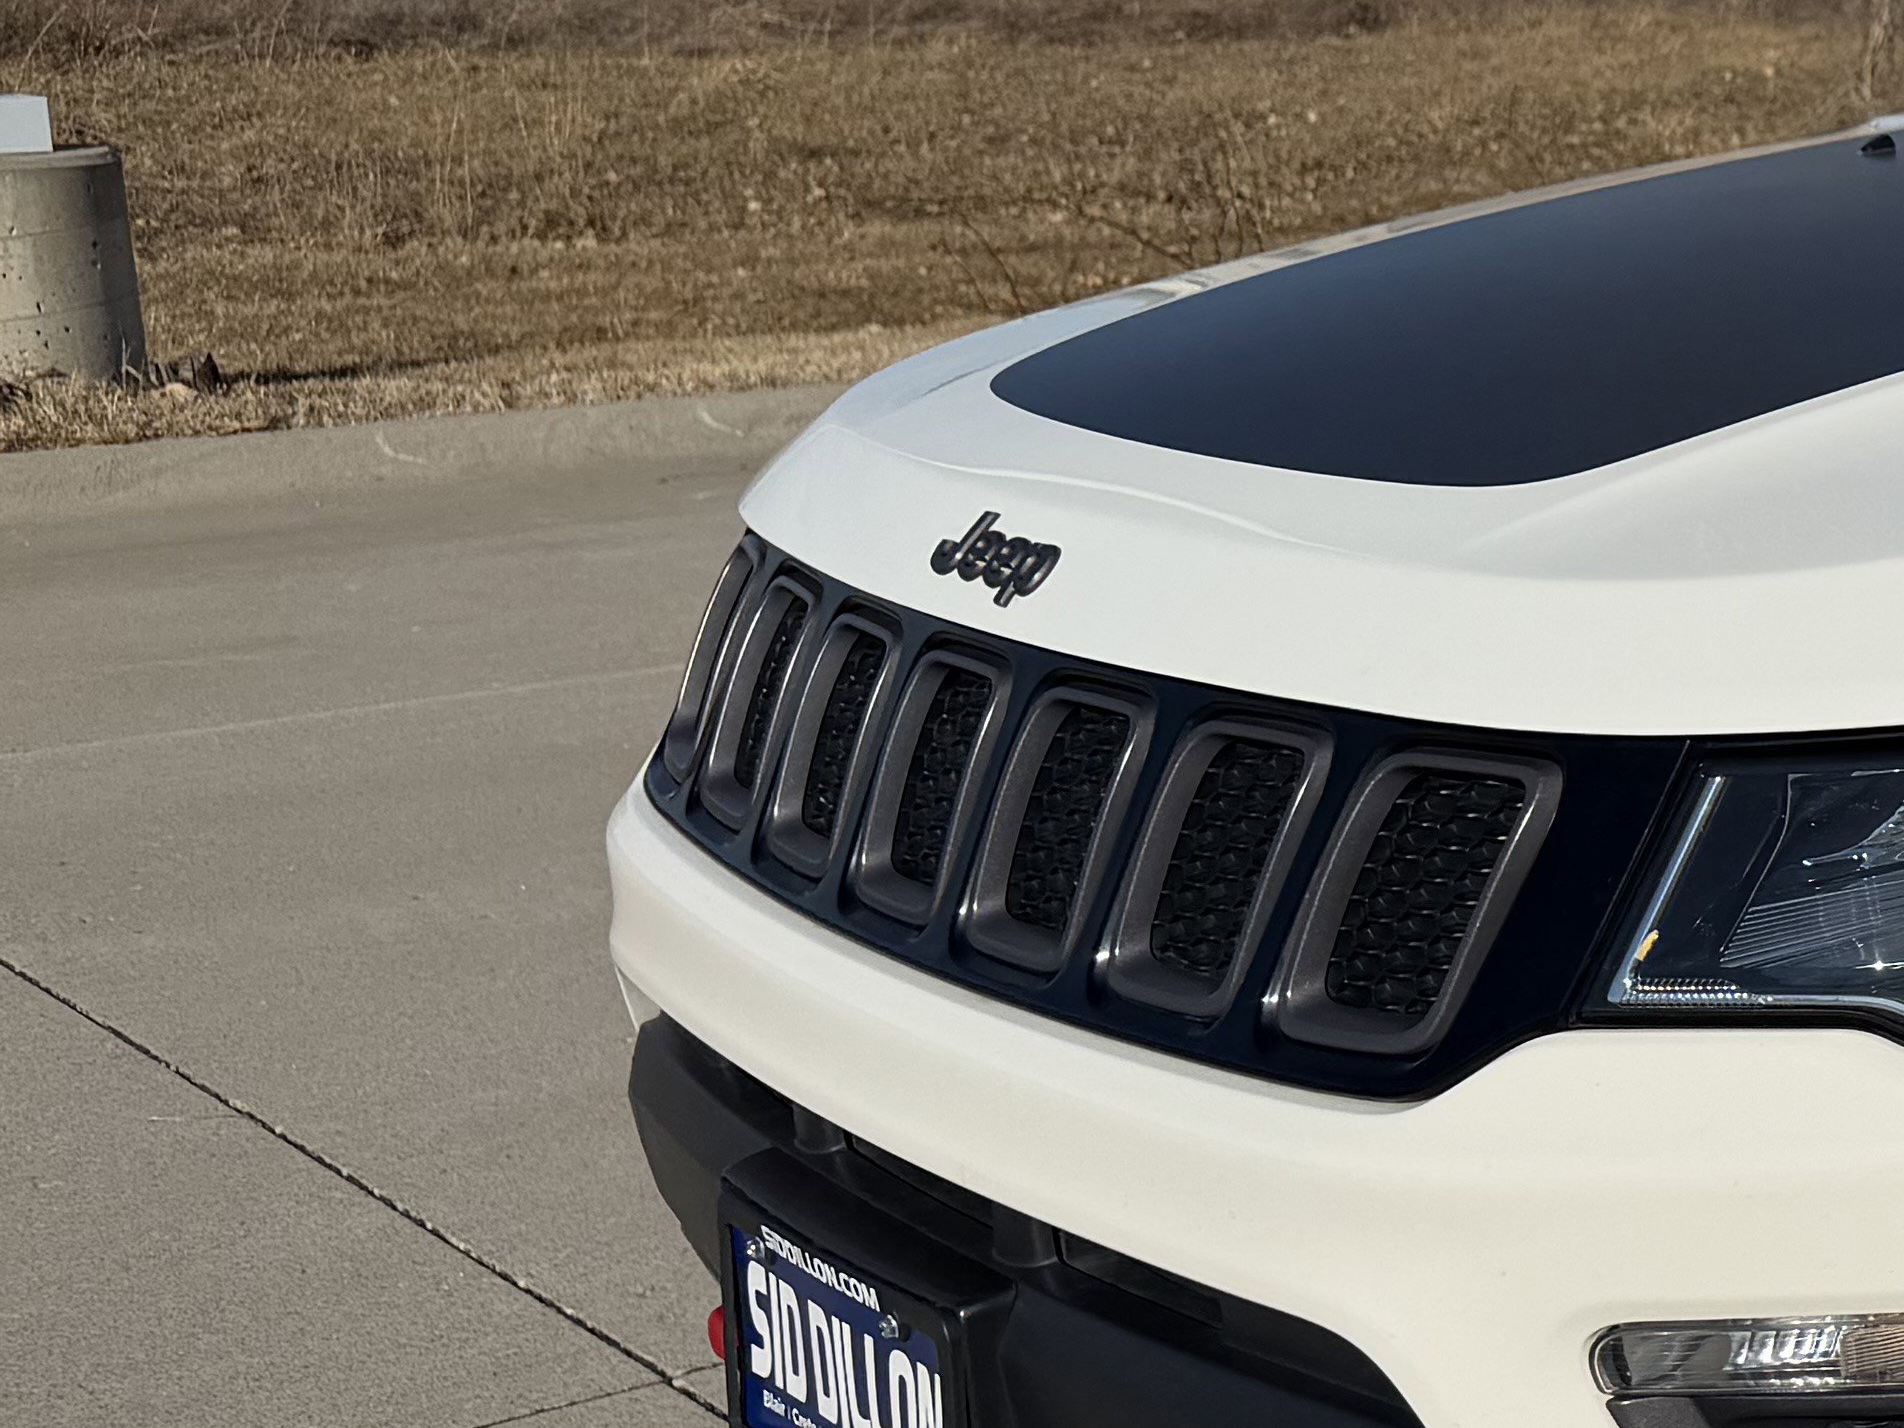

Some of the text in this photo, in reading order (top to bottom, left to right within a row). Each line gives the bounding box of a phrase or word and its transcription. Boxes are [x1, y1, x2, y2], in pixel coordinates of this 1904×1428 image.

[930, 510, 1061, 608] Jeep
[761, 1225, 881, 1312] SIDDILLON.COM
[747, 1260, 807, 1404] SID
